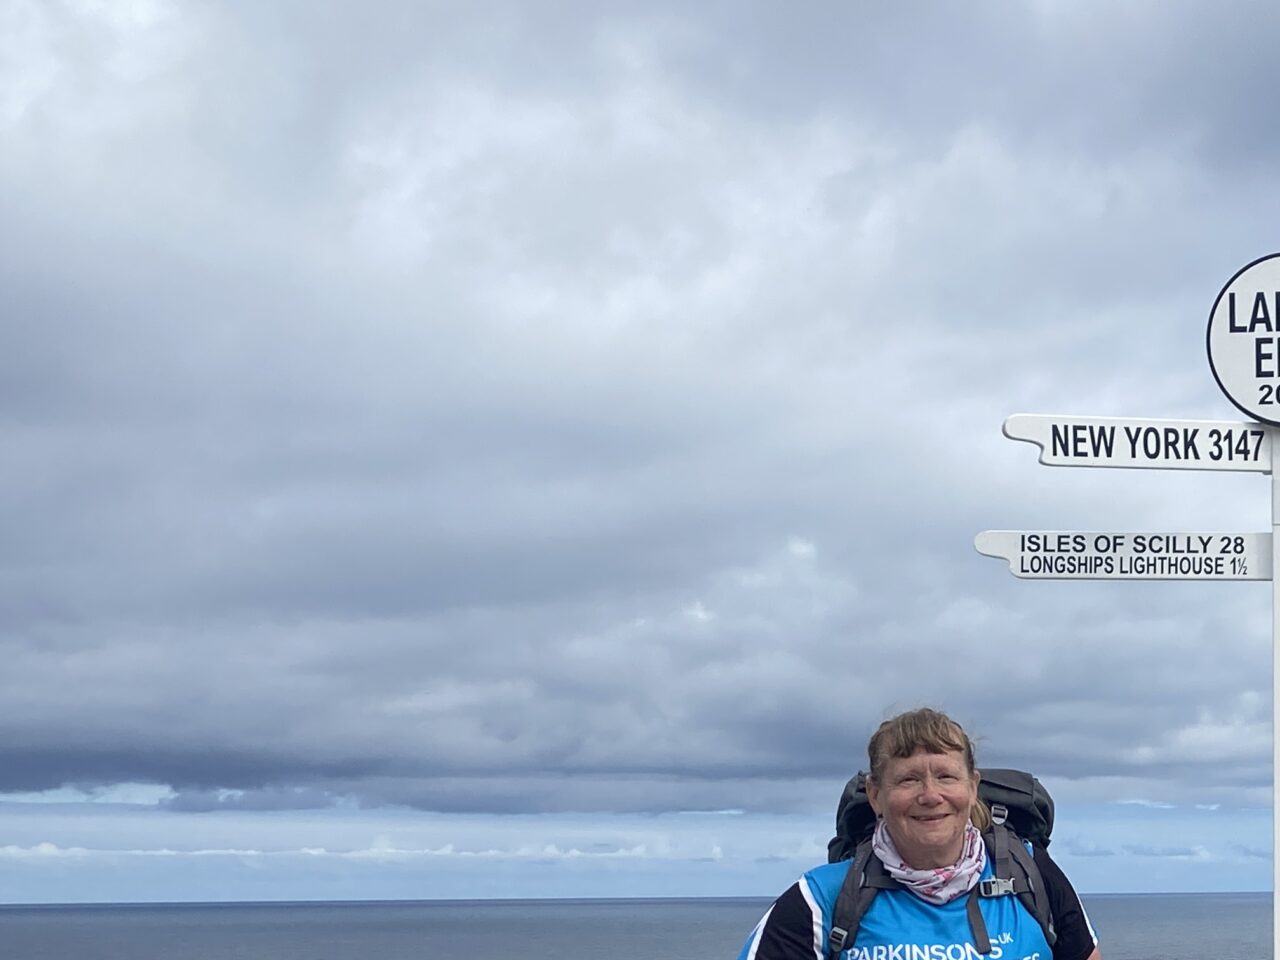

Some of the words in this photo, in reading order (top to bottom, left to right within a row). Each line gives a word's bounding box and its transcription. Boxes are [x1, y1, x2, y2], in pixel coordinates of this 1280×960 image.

[1051, 424, 1116, 458] NEW
[1124, 426, 1200, 460] YORK
[1208, 430, 1265, 462] 3147
[1020, 535, 1085, 554] ISLES
[1094, 535, 1125, 554] OF
[1132, 535, 1213, 554] SCILLY
[1219, 537, 1245, 555] 28
[1020, 556, 1114, 575] LONGSHIPS
[1120, 556, 1225, 575] LIGHTHOUSE
